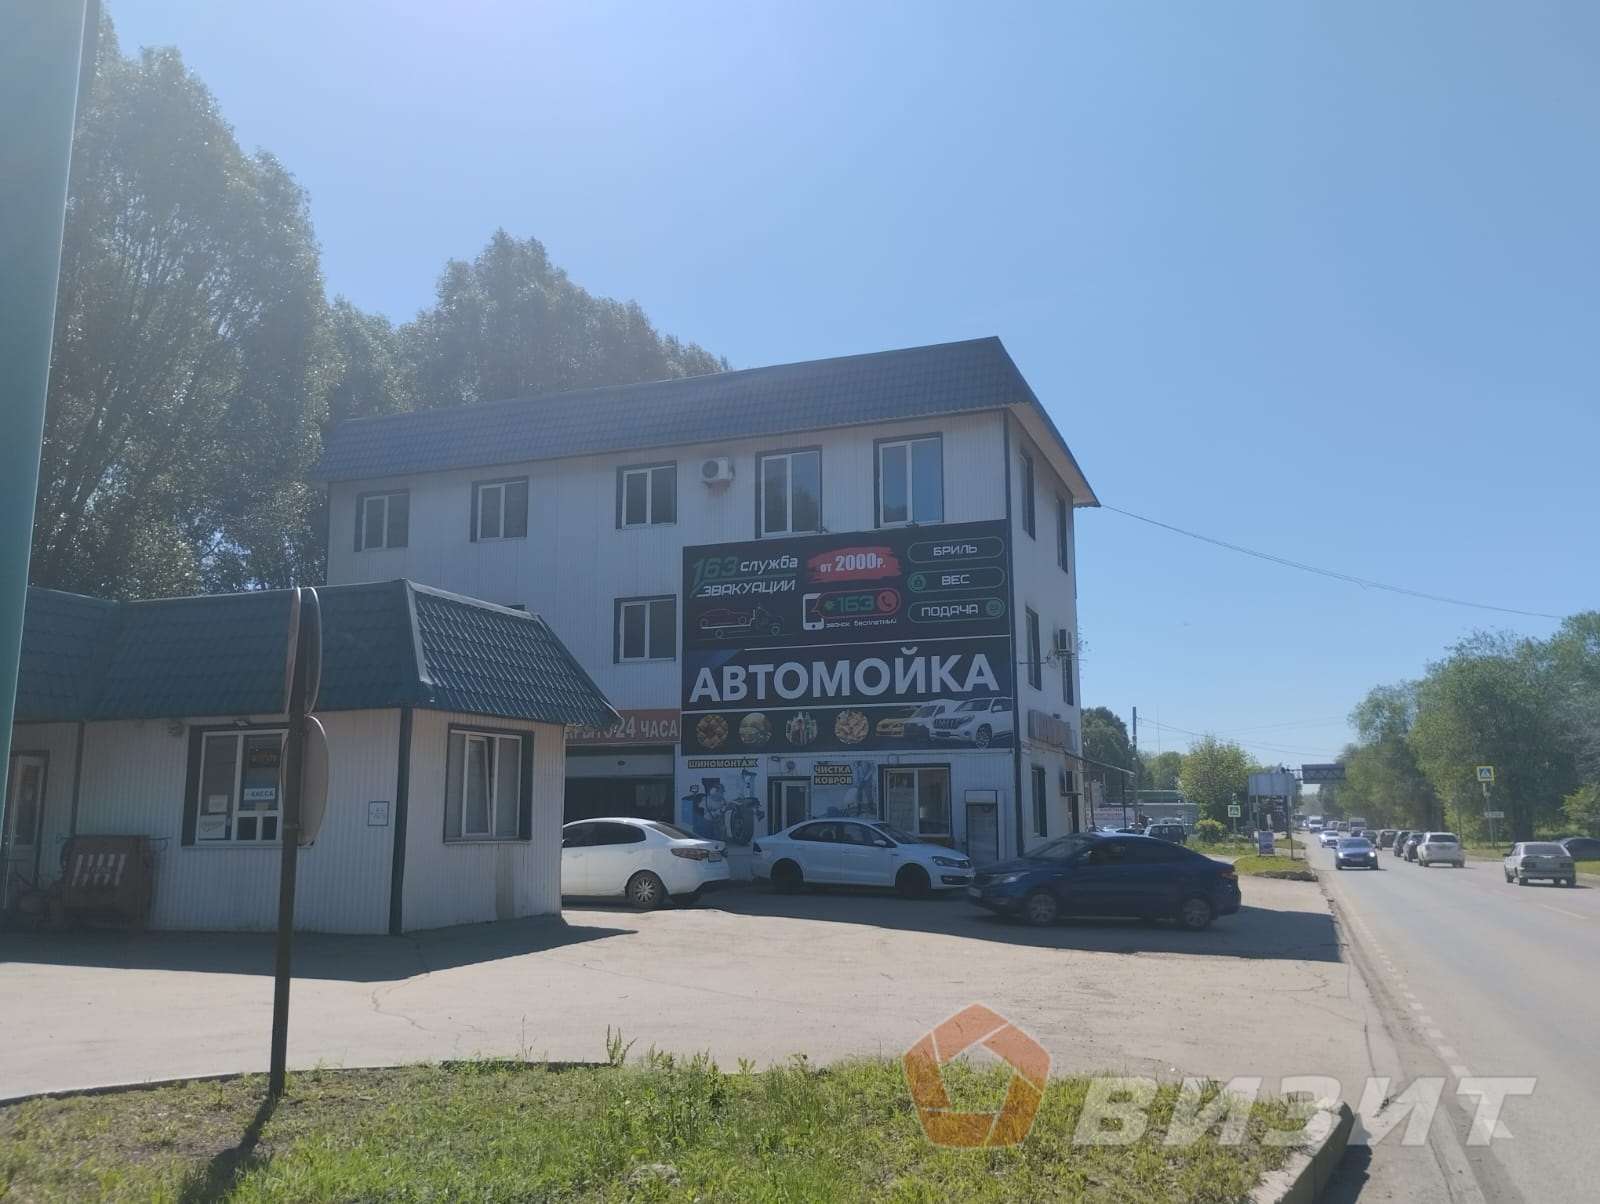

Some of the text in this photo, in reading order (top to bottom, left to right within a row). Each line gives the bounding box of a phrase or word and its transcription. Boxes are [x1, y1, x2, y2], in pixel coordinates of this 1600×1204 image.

[933, 545, 978, 557] БРИЛЬ
[740, 555, 799, 574] служба
[941, 574, 971, 586] ВЕС
[698, 579, 796, 598] ЭВАКУАЦИИ
[921, 604, 979, 618] ПОДАЧА
[689, 646, 1000, 704] АВТОМОЙКА
[616, 715, 637, 738] 24
[641, 719, 679, 738] ЧАСА
[688, 759, 758, 769] ШИНОМОНТАЖ
[815, 764, 853, 774] ЧИСТКА
[815, 775, 853, 785] КОВРОВ
